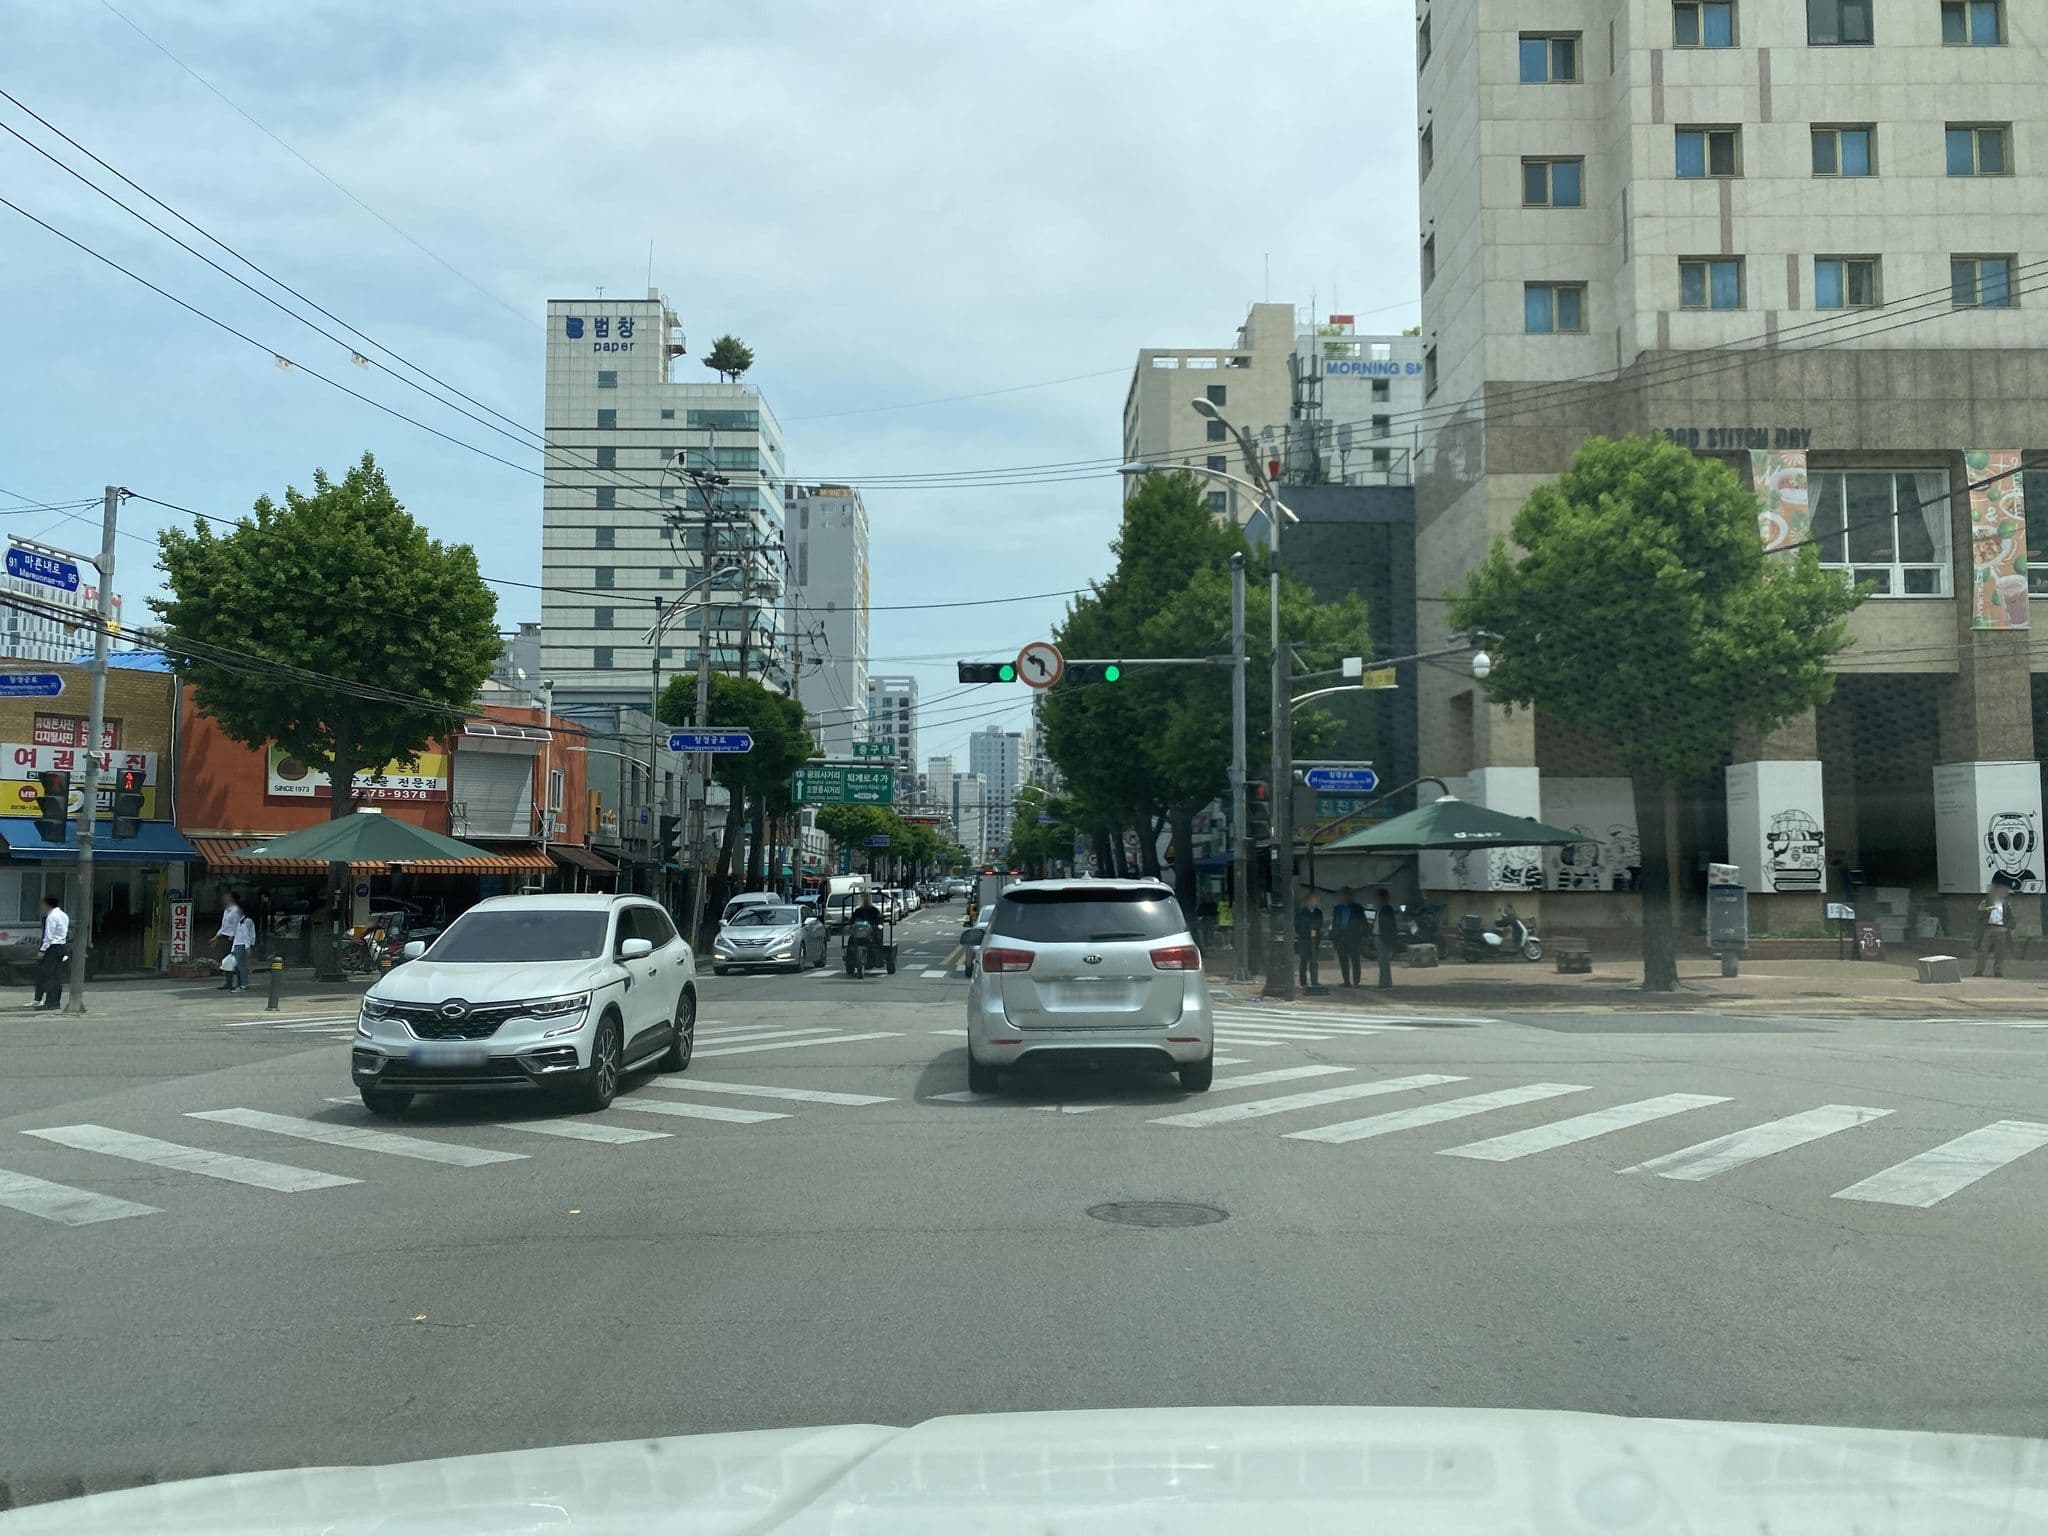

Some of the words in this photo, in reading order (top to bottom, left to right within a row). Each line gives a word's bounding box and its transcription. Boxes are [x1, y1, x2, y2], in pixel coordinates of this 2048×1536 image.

[594, 316, 635, 338] 범창
[593, 342, 635, 352] paper
[1326, 362, 1400, 375] MORNING
[8, 557, 17, 568] 91
[24, 555, 61, 575] 마른내로
[67, 572, 77, 584] 95
[274, 784, 294, 792] SINCE
[398, 777, 437, 789] 전문점
[351, 789, 427, 799] 275-9378
[173, 905, 188, 955] 여권사진
